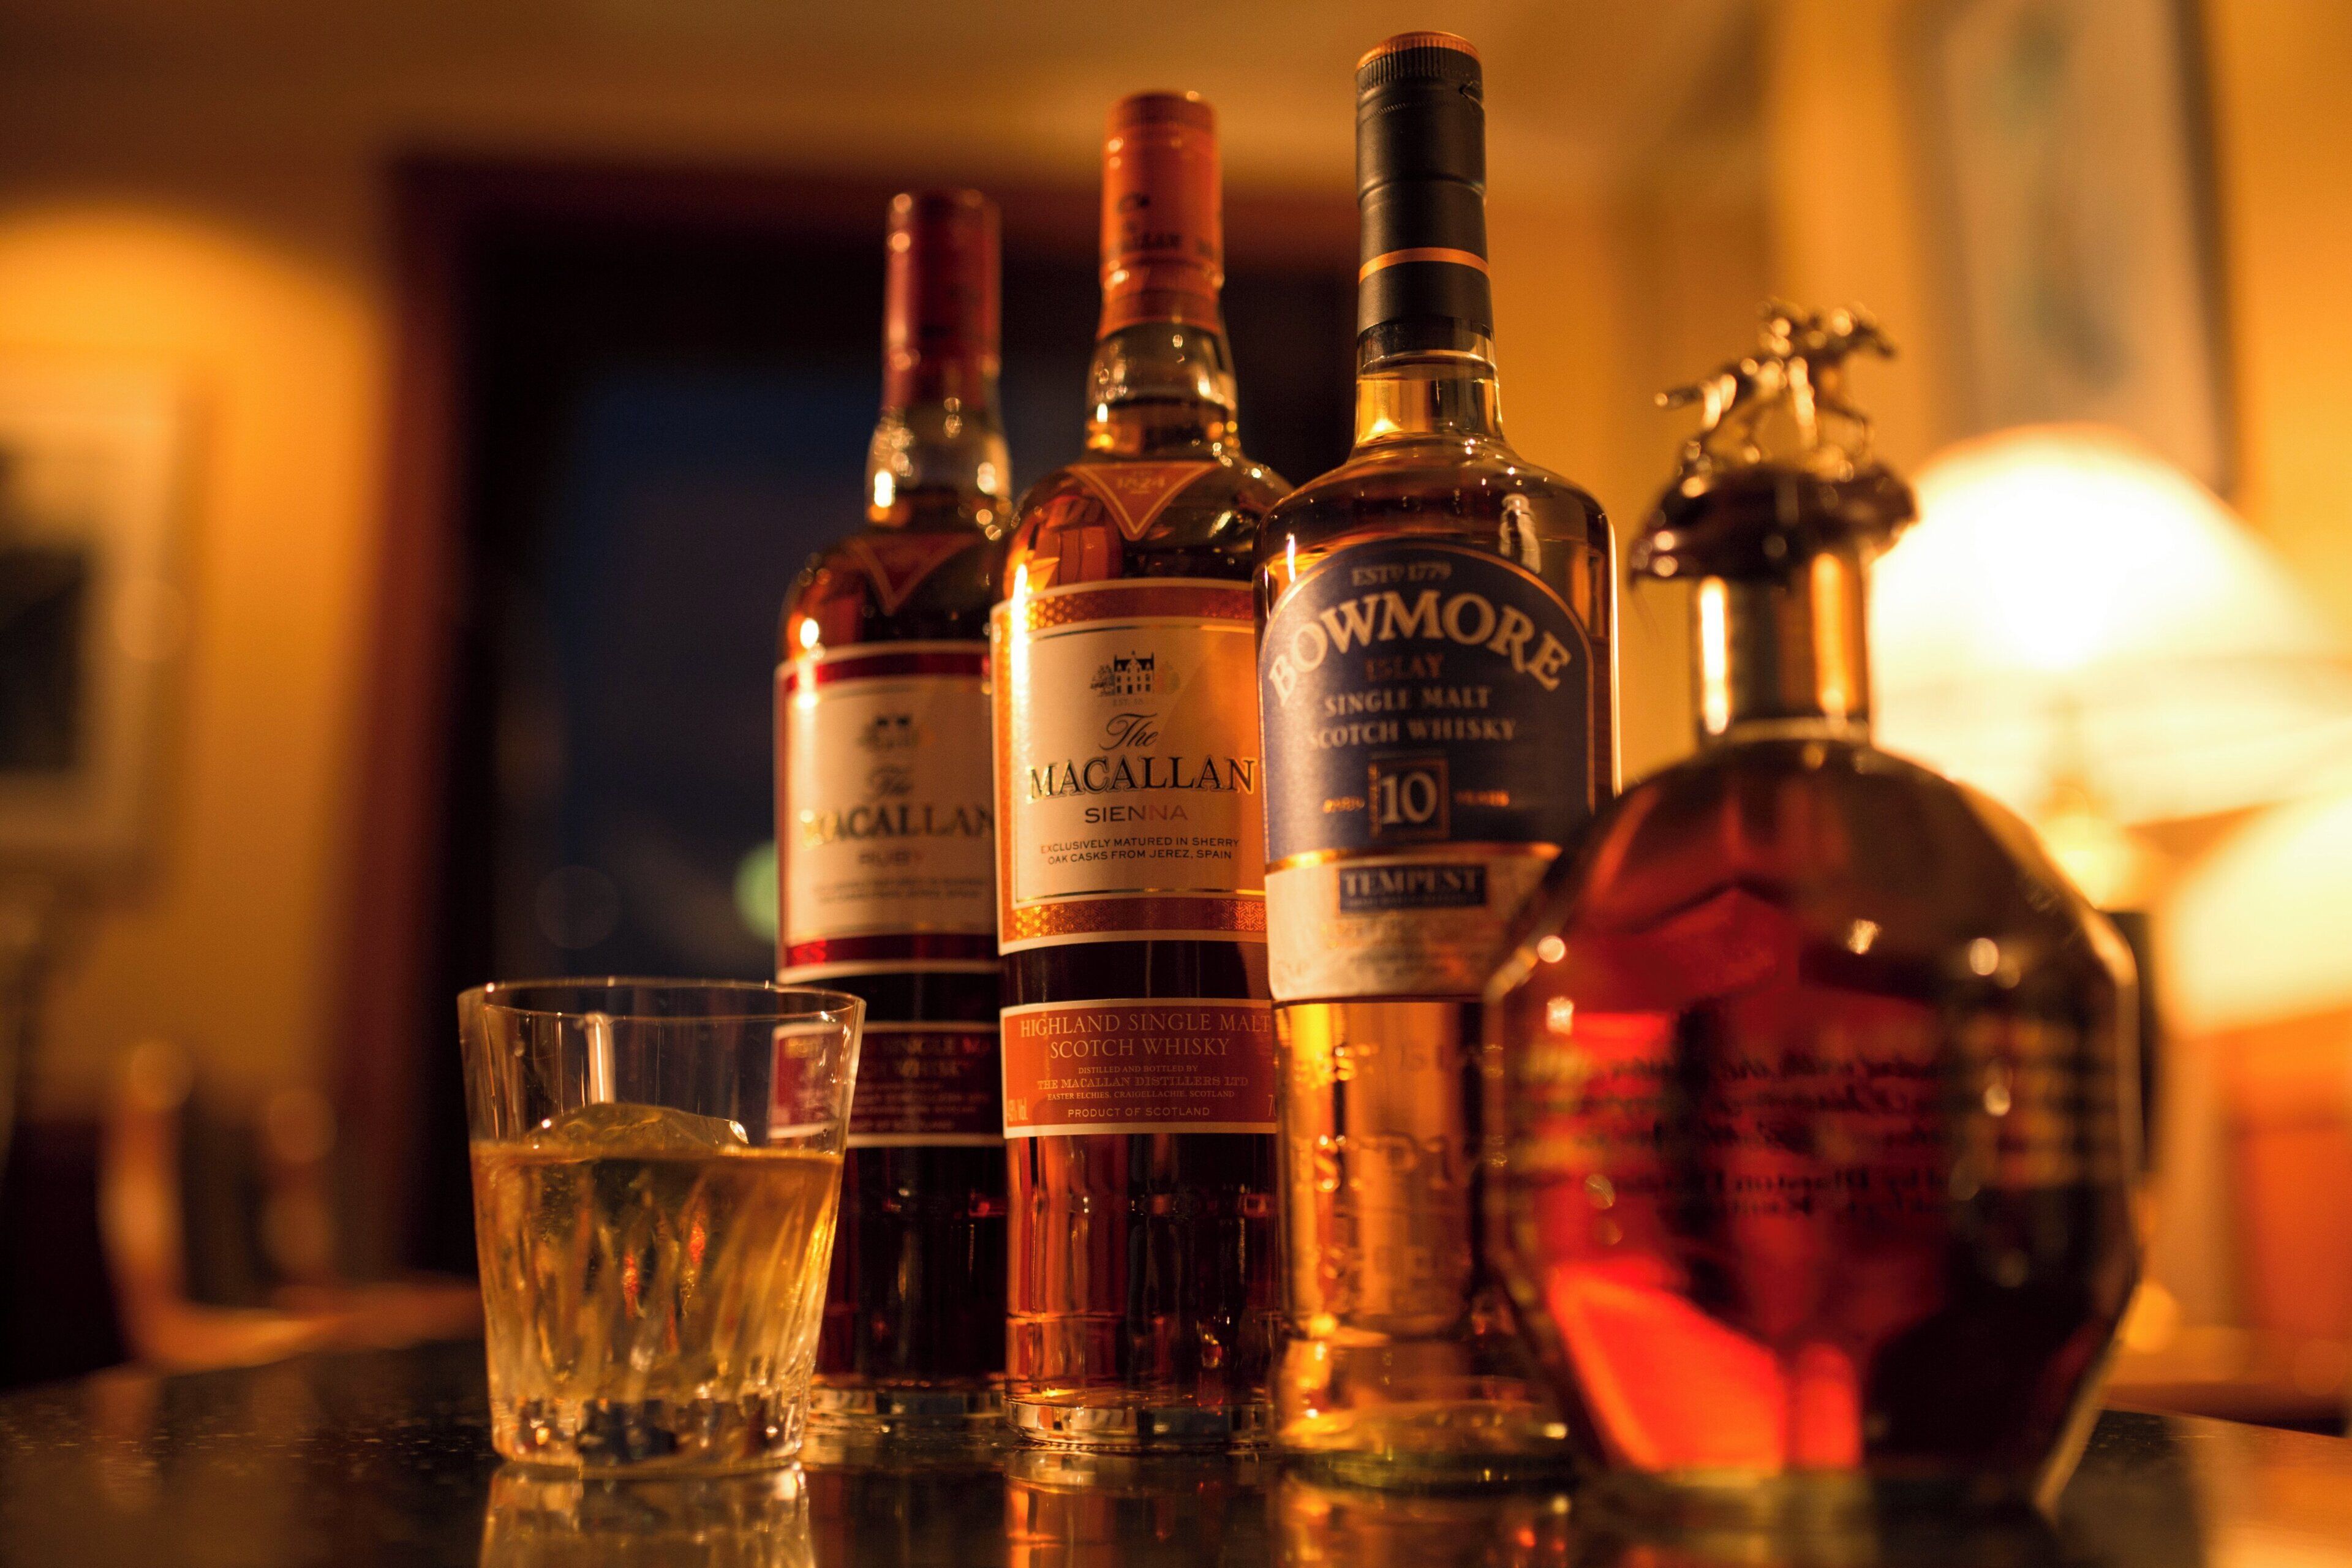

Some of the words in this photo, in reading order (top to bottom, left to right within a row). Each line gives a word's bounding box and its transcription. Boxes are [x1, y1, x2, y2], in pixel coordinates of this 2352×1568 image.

[1268, 589, 1572, 706] BOWMORE
[1364, 652, 1445, 680] ISLAY
[1324, 688, 1408, 718] SINGLE
[1420, 685, 1493, 709] MALT
[1099, 713, 1158, 750] The
[1307, 719, 1399, 750] SCOTCH
[1406, 717, 1517, 742] WHISKY
[1027, 755, 1258, 802] MACALLAN
[1378, 770, 1438, 825] 10
[1085, 804, 1188, 824] SIENNA
[1041, 839, 1110, 854] EXCLUSIVELY
[1114, 837, 1172, 847] MATURED
[1176, 837, 1188, 846] IN
[1192, 837, 1239, 848] SHERRY
[1048, 855, 1068, 865] OAK
[1071, 851, 1107, 862] CASKS
[1112, 850, 1145, 859] FROM
[1149, 850, 1193, 861] JEREZ,
[1197, 850, 1231, 859] SPAIN
[1020, 1014, 1120, 1038] HIGHLAND
[1129, 1012, 1212, 1032] SINGLE
[1219, 1013, 1270, 1033] MALT
[1050, 1039, 1134, 1059] SCOTCH
[1141, 1038, 1230, 1056] WHISKY
[1038, 1080, 1058, 1090] THE
[1061, 1077, 1130, 1088] MACALLAN
[1135, 1076, 1221, 1087] DISTILLERS
[1224, 1076, 1249, 1087] LTD
[1047, 1092, 1074, 1101] EASTER
[1068, 1107, 1121, 1118] PRODUCT
[1125, 1107, 1140, 1117] OF
[1145, 1107, 1210, 1117] SCOTLAND
